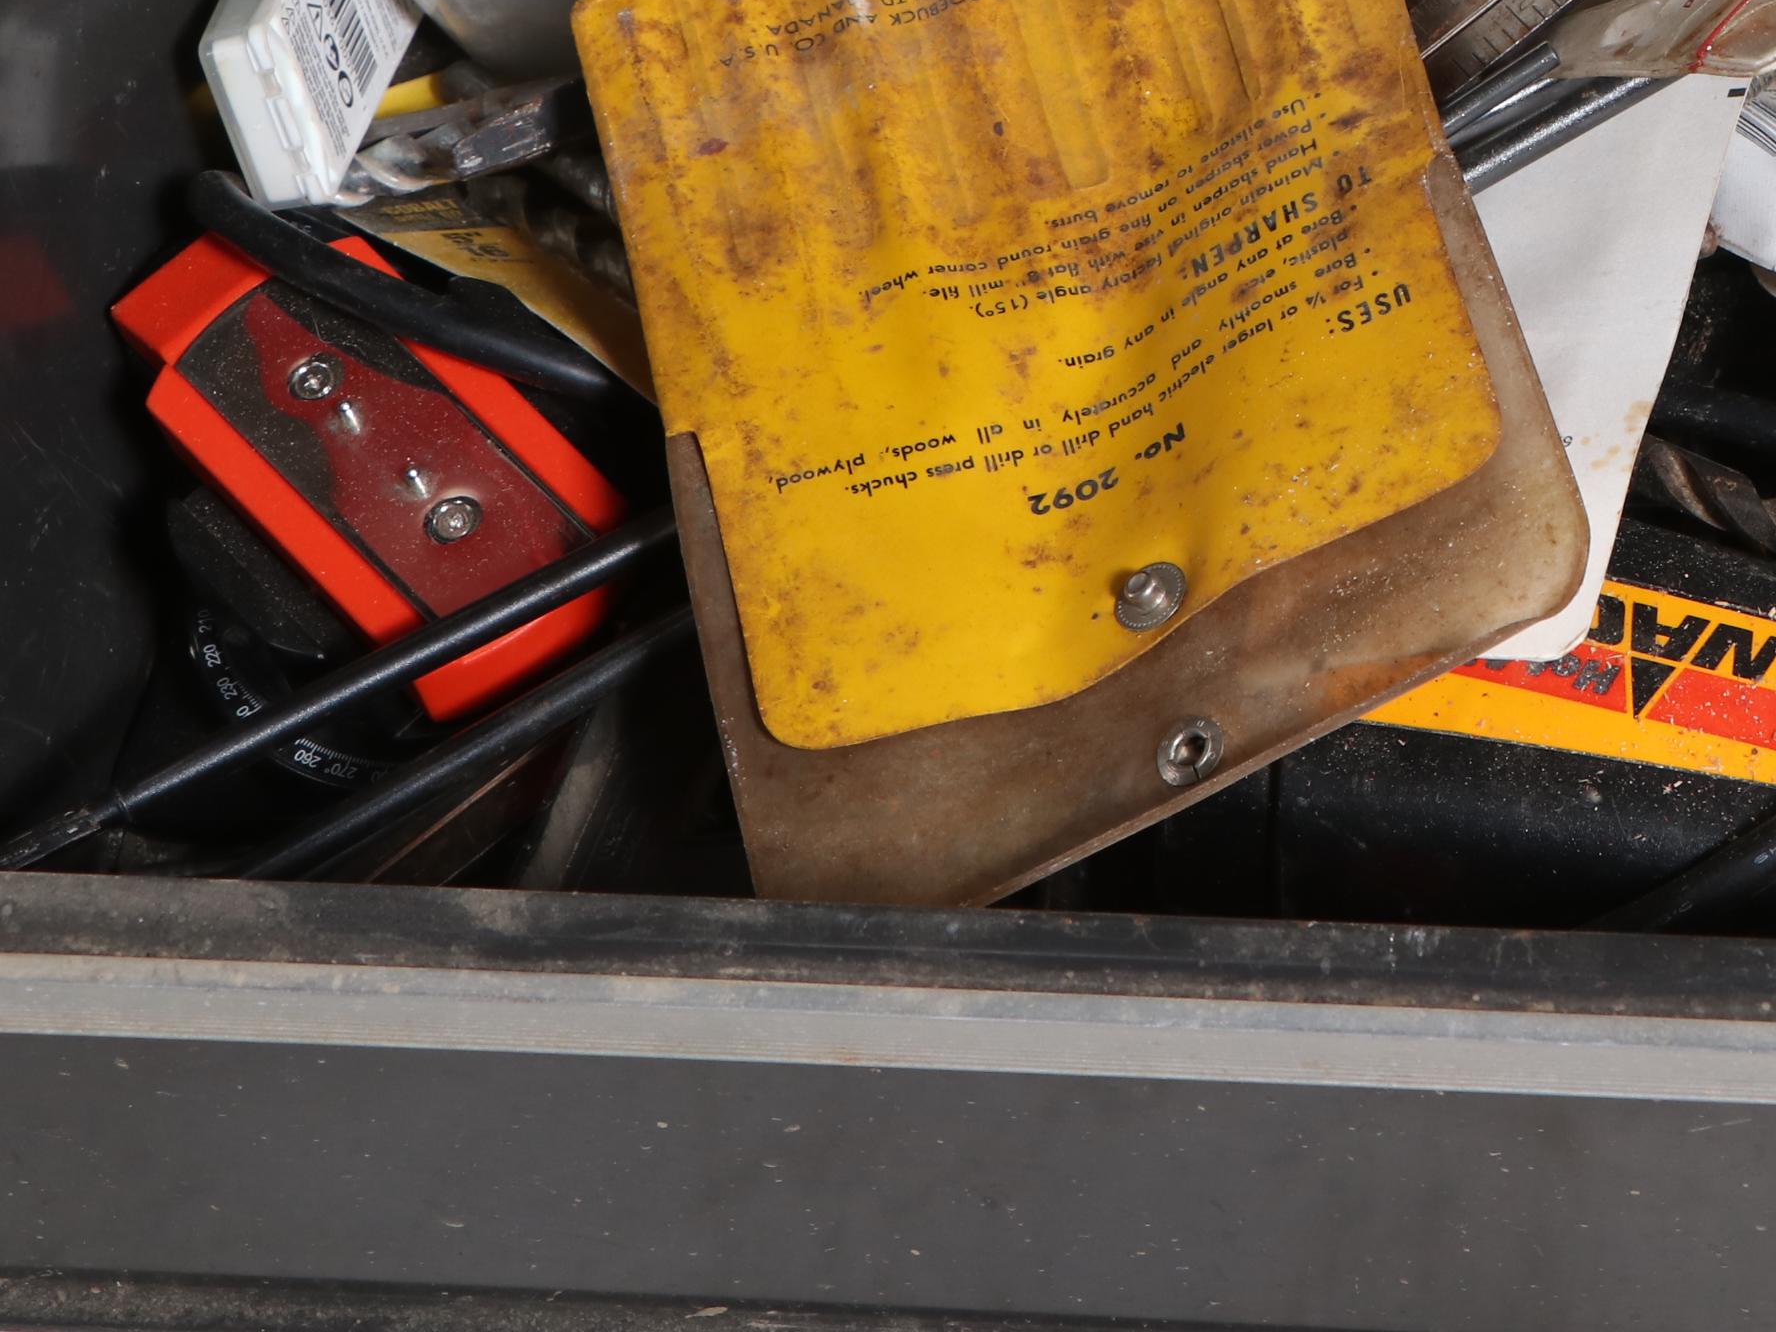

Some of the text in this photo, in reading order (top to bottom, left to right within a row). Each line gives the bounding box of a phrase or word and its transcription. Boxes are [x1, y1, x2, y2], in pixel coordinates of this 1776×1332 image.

[832, 12, 877, 35] AND
[1271, 97, 1306, 121] Use
[1199, 118, 1264, 164] oilstone
[1264, 137, 1316, 173] Hand
[1176, 164, 1193, 181] to
[1239, 154, 1323, 206] Maintain
[1103, 177, 1169, 215] remove
[1191, 168, 1258, 212] sharpen
[857, 118, 1312, 304] Power sharpen on fine grain round corner wheel.
[1170, 212, 1185, 227] in
[1177, 164, 1373, 280] TO SHARPEN:
[1133, 227, 1163, 252] vise
[1166, 204, 1231, 257] original
[1281, 227, 1350, 266] plastic,
[1046, 261, 1079, 278] flat
[1086, 250, 1125, 271] with
[1100, 253, 1161, 294] factory
[921, 285, 959, 300] file.
[968, 279, 1003, 297] mill
[1035, 282, 1091, 303] angle
[1057, 208, 1343, 368] Bore at any angle in any grain.
[1332, 275, 1363, 294] For
[1278, 304, 1297, 318] or
[1323, 282, 1411, 334] USES:
[1221, 317, 1272, 353] larger
[767, 252, 1356, 493] Bore smoothly and accurately in all woods, plywood,
[1157, 353, 1214, 402] electric
[1107, 401, 1152, 437] hand
[1032, 443, 1052, 457] or
[1060, 428, 1100, 455] drill
[925, 455, 974, 478] press
[982, 448, 1023, 471] drill
[1026, 422, 1185, 515] No. 2092
[843, 470, 917, 495] chucks.
[203, 642, 222, 668] 220
[216, 676, 238, 700] 230
[294, 748, 322, 769] 260
